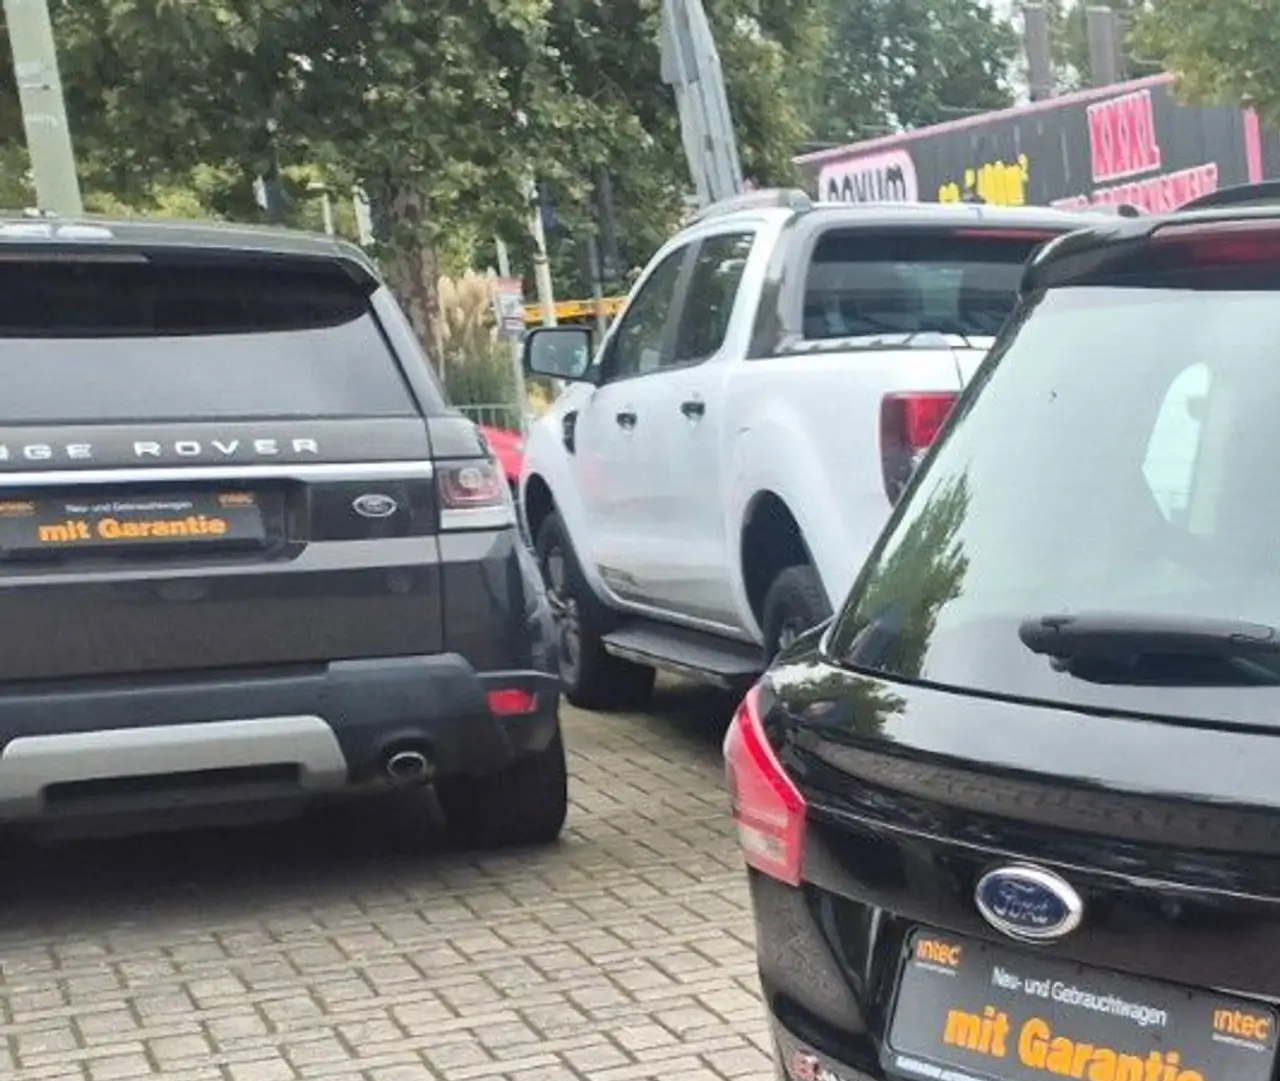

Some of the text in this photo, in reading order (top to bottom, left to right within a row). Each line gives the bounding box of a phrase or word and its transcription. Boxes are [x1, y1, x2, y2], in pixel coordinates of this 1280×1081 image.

[134, 438, 318, 458] ROVER
[39, 514, 228, 541] mit Garantie
[992, 880, 1049, 924] Ford
[992, 966, 1167, 1026] Neu- und Gebrauchtwagen
[944, 1005, 1009, 1057] mit
